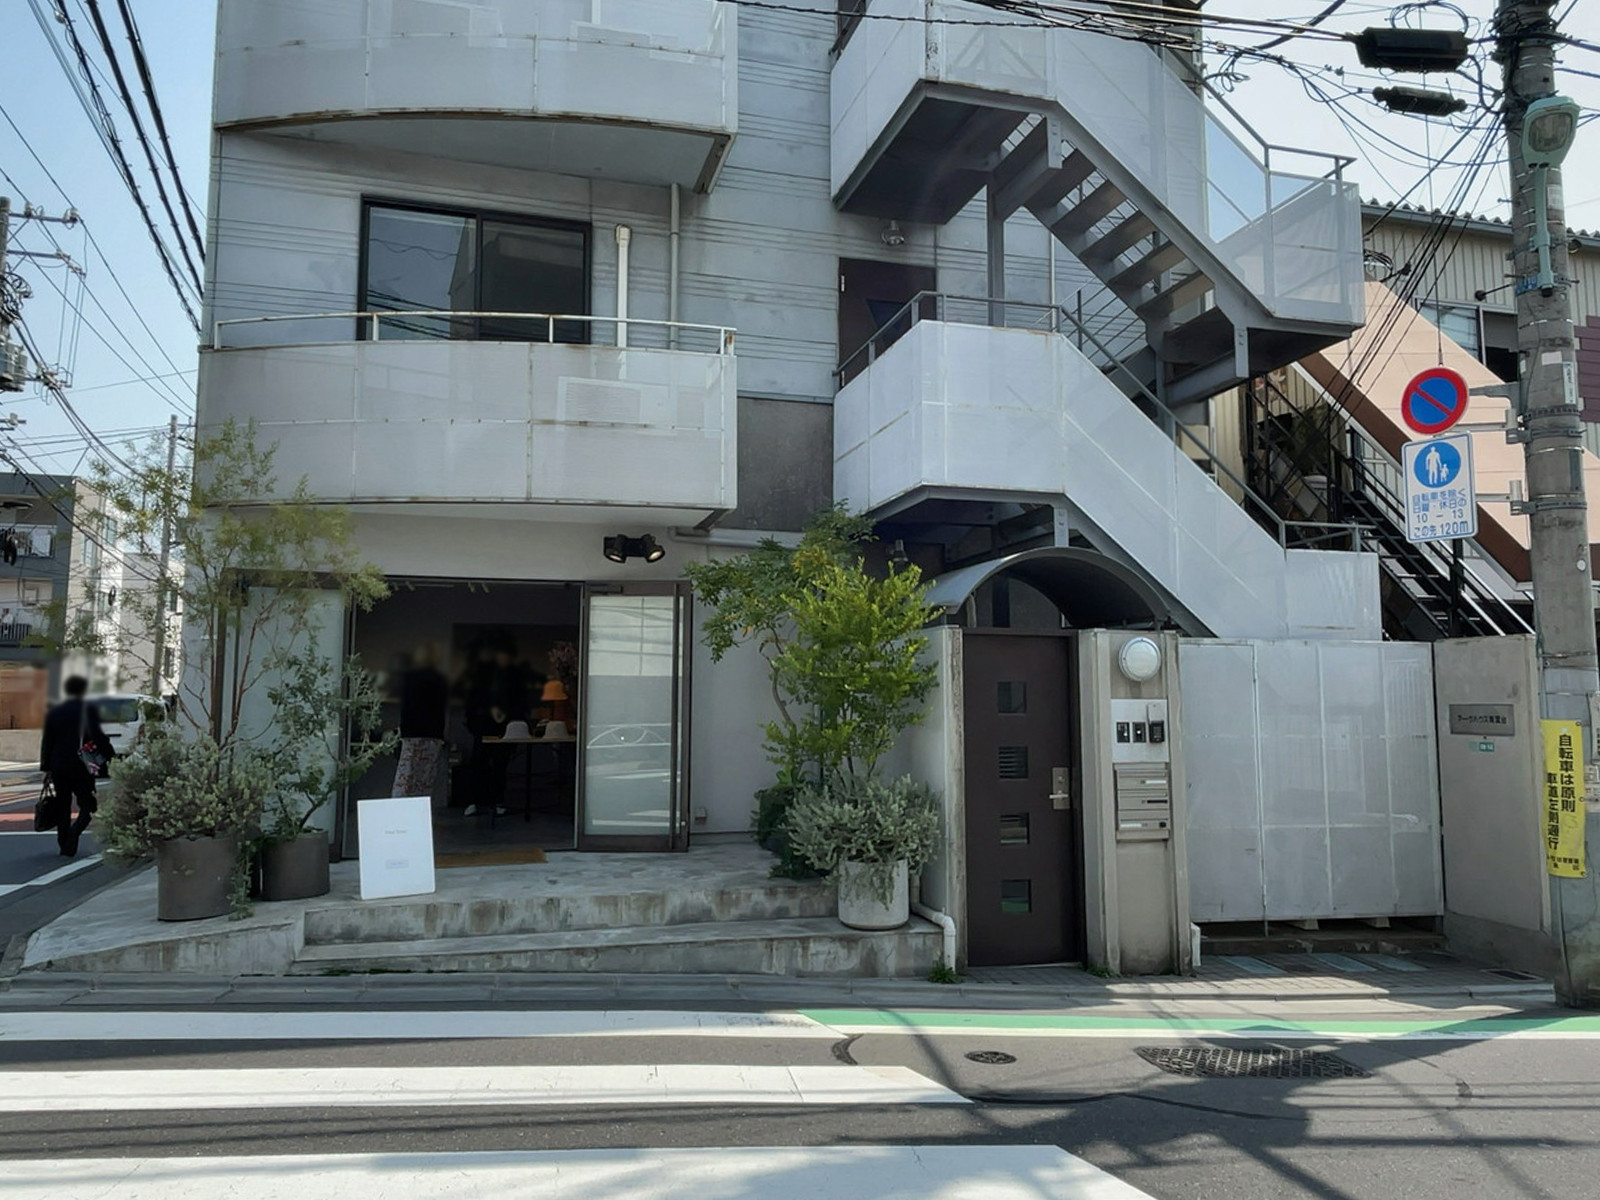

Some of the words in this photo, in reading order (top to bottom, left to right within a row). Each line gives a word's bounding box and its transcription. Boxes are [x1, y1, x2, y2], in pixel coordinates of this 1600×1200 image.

[1412, 488, 1466, 505] 自転車を除く
[1416, 512, 1428, 523] 10
[1452, 508, 1464, 519] 13
[1558, 733, 1576, 813] 自転車は原則
[1547, 772, 1559, 850] 車道左側通行
